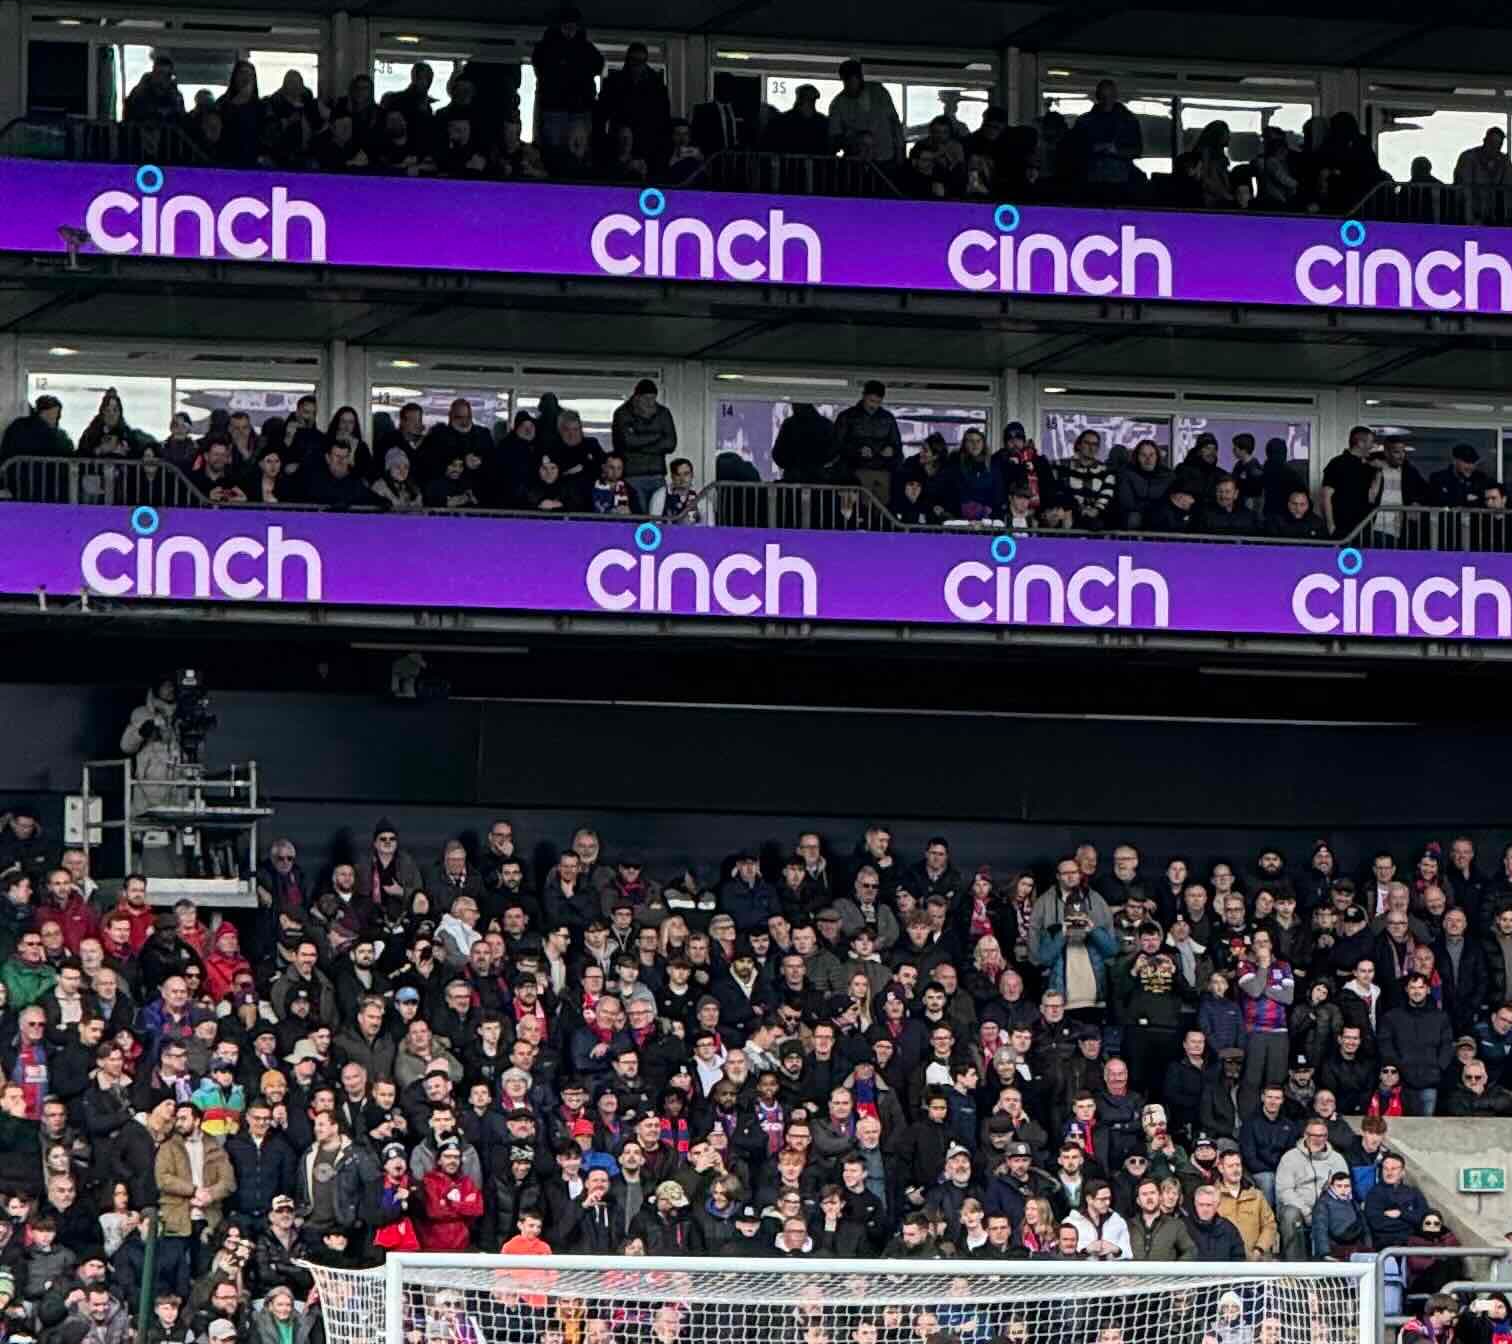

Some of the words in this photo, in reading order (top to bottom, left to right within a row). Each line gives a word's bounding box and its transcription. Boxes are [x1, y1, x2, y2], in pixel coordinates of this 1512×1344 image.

[772, 80, 787, 94] 35
[87, 165, 325, 261] cinch
[592, 189, 820, 282] cinch
[949, 205, 1171, 296] cinch
[1296, 220, 1512, 311] cinch
[82, 507, 321, 600] cinch
[587, 523, 816, 615] cinch
[945, 536, 1168, 627] cinch
[1293, 548, 1511, 636] cinch
